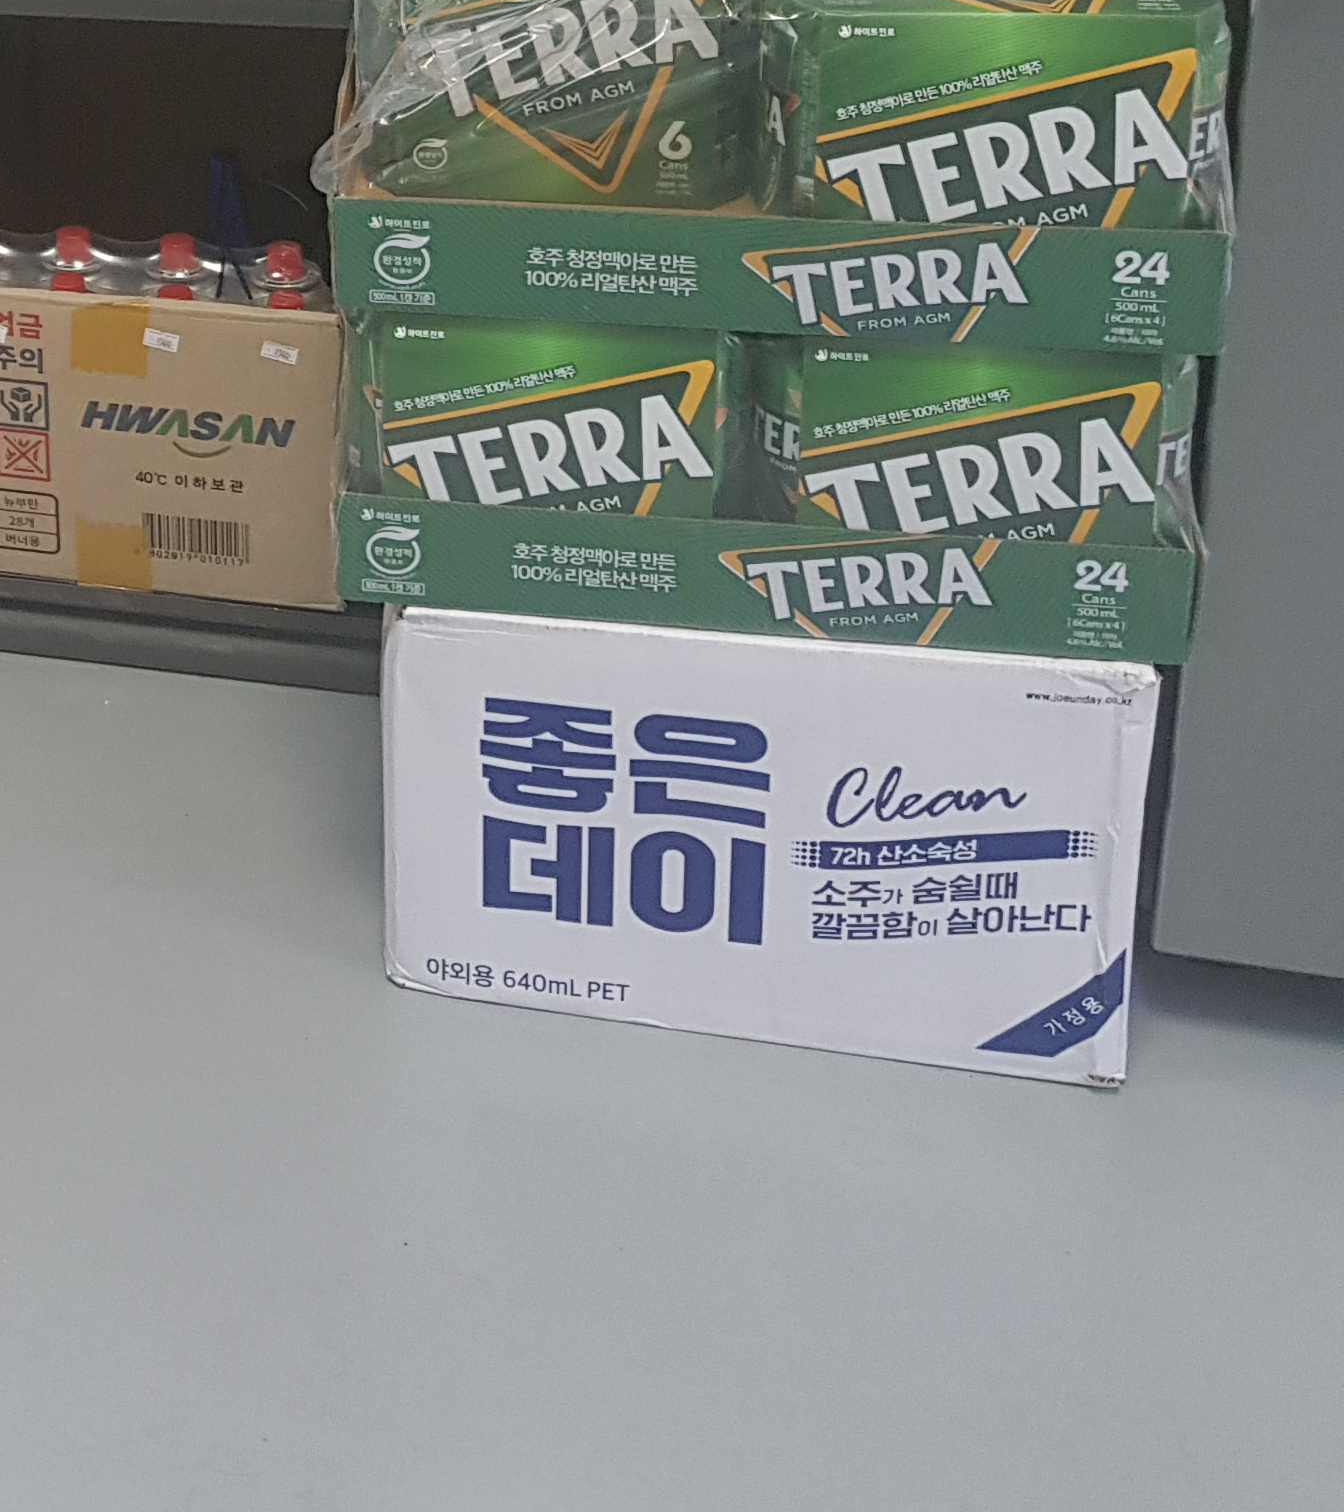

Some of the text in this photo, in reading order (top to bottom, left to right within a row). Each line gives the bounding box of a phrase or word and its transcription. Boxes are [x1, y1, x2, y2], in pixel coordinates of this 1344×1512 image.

[522, 80, 637, 119] FROM AGM
[939, 77, 972, 99] 100%
[658, 120, 693, 160] 6
[827, 89, 1189, 225] TERRA
[1038, 203, 1089, 227] AGM
[526, 247, 698, 273] 호주 청정맥아로 만든
[1112, 250, 1170, 285] 24
[525, 270, 698, 297] 100% 리얼탄산 맥주
[772, 241, 1030, 326] TERRA
[1120, 286, 1157, 298] Cans
[857, 311, 951, 331] FROM AGM
[485, 376, 513, 396] 100%
[912, 396, 944, 418] 100%
[81, 400, 296, 448] HWASAN
[389, 395, 714, 506] TERRA
[805, 418, 1155, 535] TERRA
[577, 495, 622, 513] AGM
[9, 514, 34, 528] 28개
[1007, 523, 1055, 541] AGM
[512, 542, 677, 569] 호주 청정맥아로 만든
[511, 563, 677, 592] 100% 리얼탄산 맥주
[748, 548, 992, 620] TERRA
[1074, 559, 1129, 592] 24
[1081, 593, 1116, 605] Cans
[829, 610, 919, 629] FROM AGM
[480, 696, 772, 830] 좋은
[826, 765, 1028, 828] Clean
[830, 838, 979, 867] 72h 산소숙성
[481, 814, 766, 947] 데이
[812, 871, 1019, 908] 소주가 숨쉴때
[812, 903, 1092, 941] 깔끔함이 살아난다
[425, 957, 631, 1004] 야외용 640mL PET
[1043, 996, 1105, 1036] 가정용
